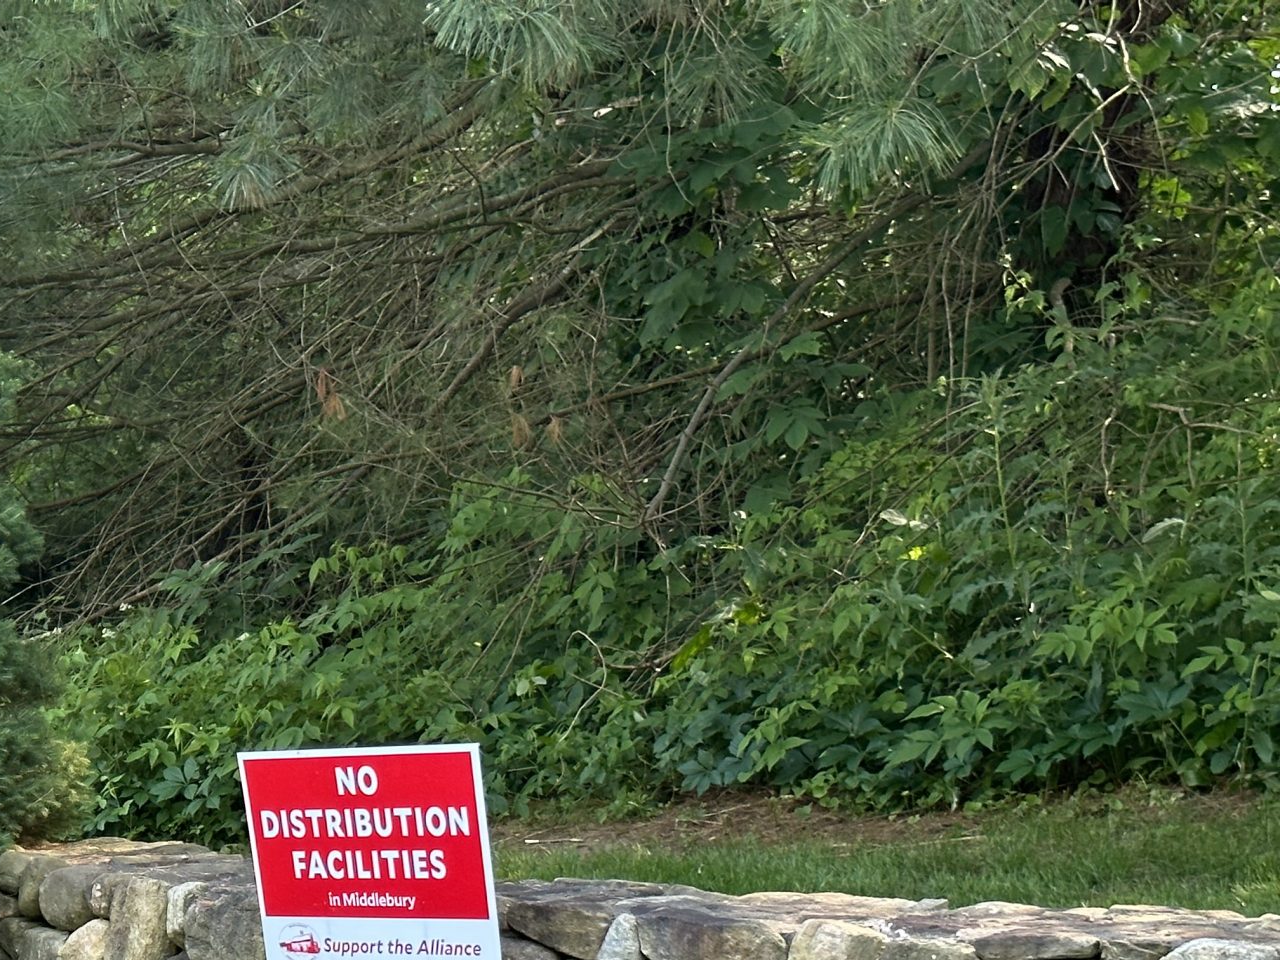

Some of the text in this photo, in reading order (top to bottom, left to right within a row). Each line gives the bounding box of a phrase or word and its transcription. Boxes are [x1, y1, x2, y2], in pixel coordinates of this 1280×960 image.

[334, 765, 379, 796] NO
[260, 806, 470, 839] DISTRIBUTION
[291, 849, 447, 880] FACILITIES
[328, 891, 416, 910] in Middlebury
[324, 938, 481, 956] Support the Alliance
